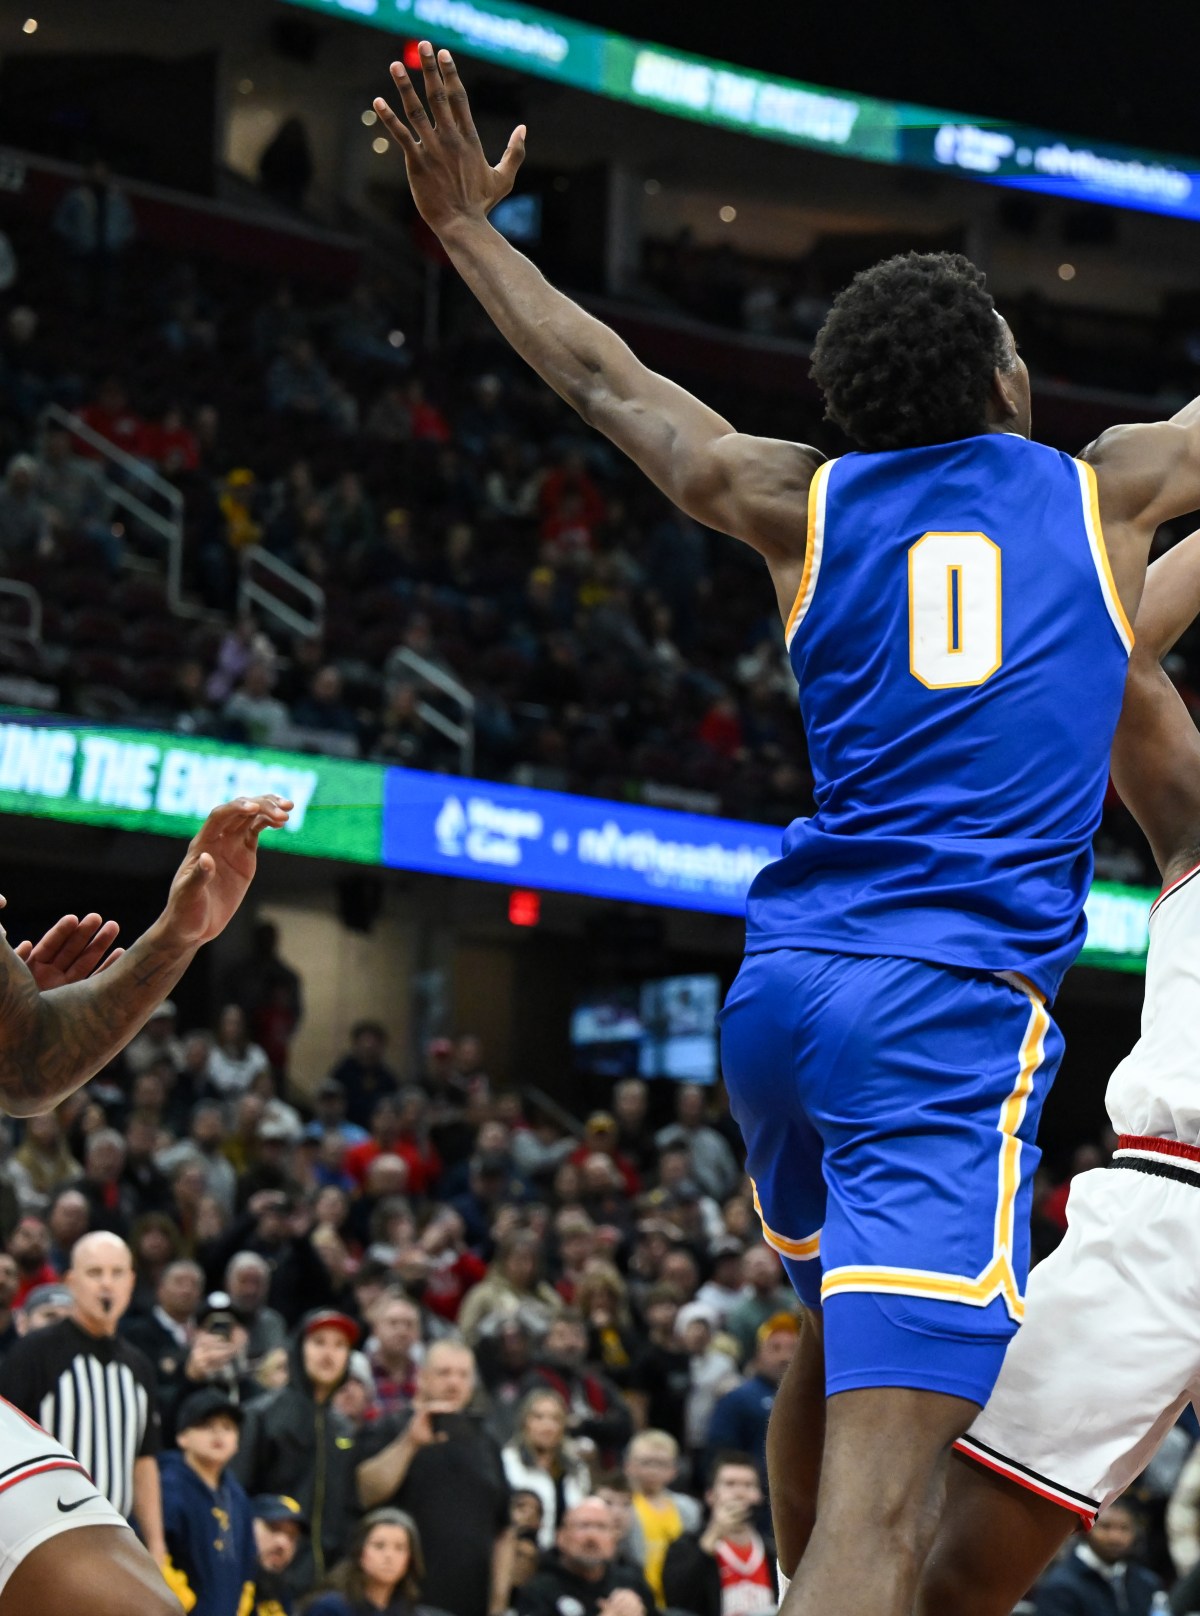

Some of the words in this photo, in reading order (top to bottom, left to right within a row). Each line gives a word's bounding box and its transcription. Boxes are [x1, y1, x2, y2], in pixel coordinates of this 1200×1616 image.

[908, 532, 1002, 690] 0
[0, 722, 77, 799] ING
[78, 735, 159, 812] THE
